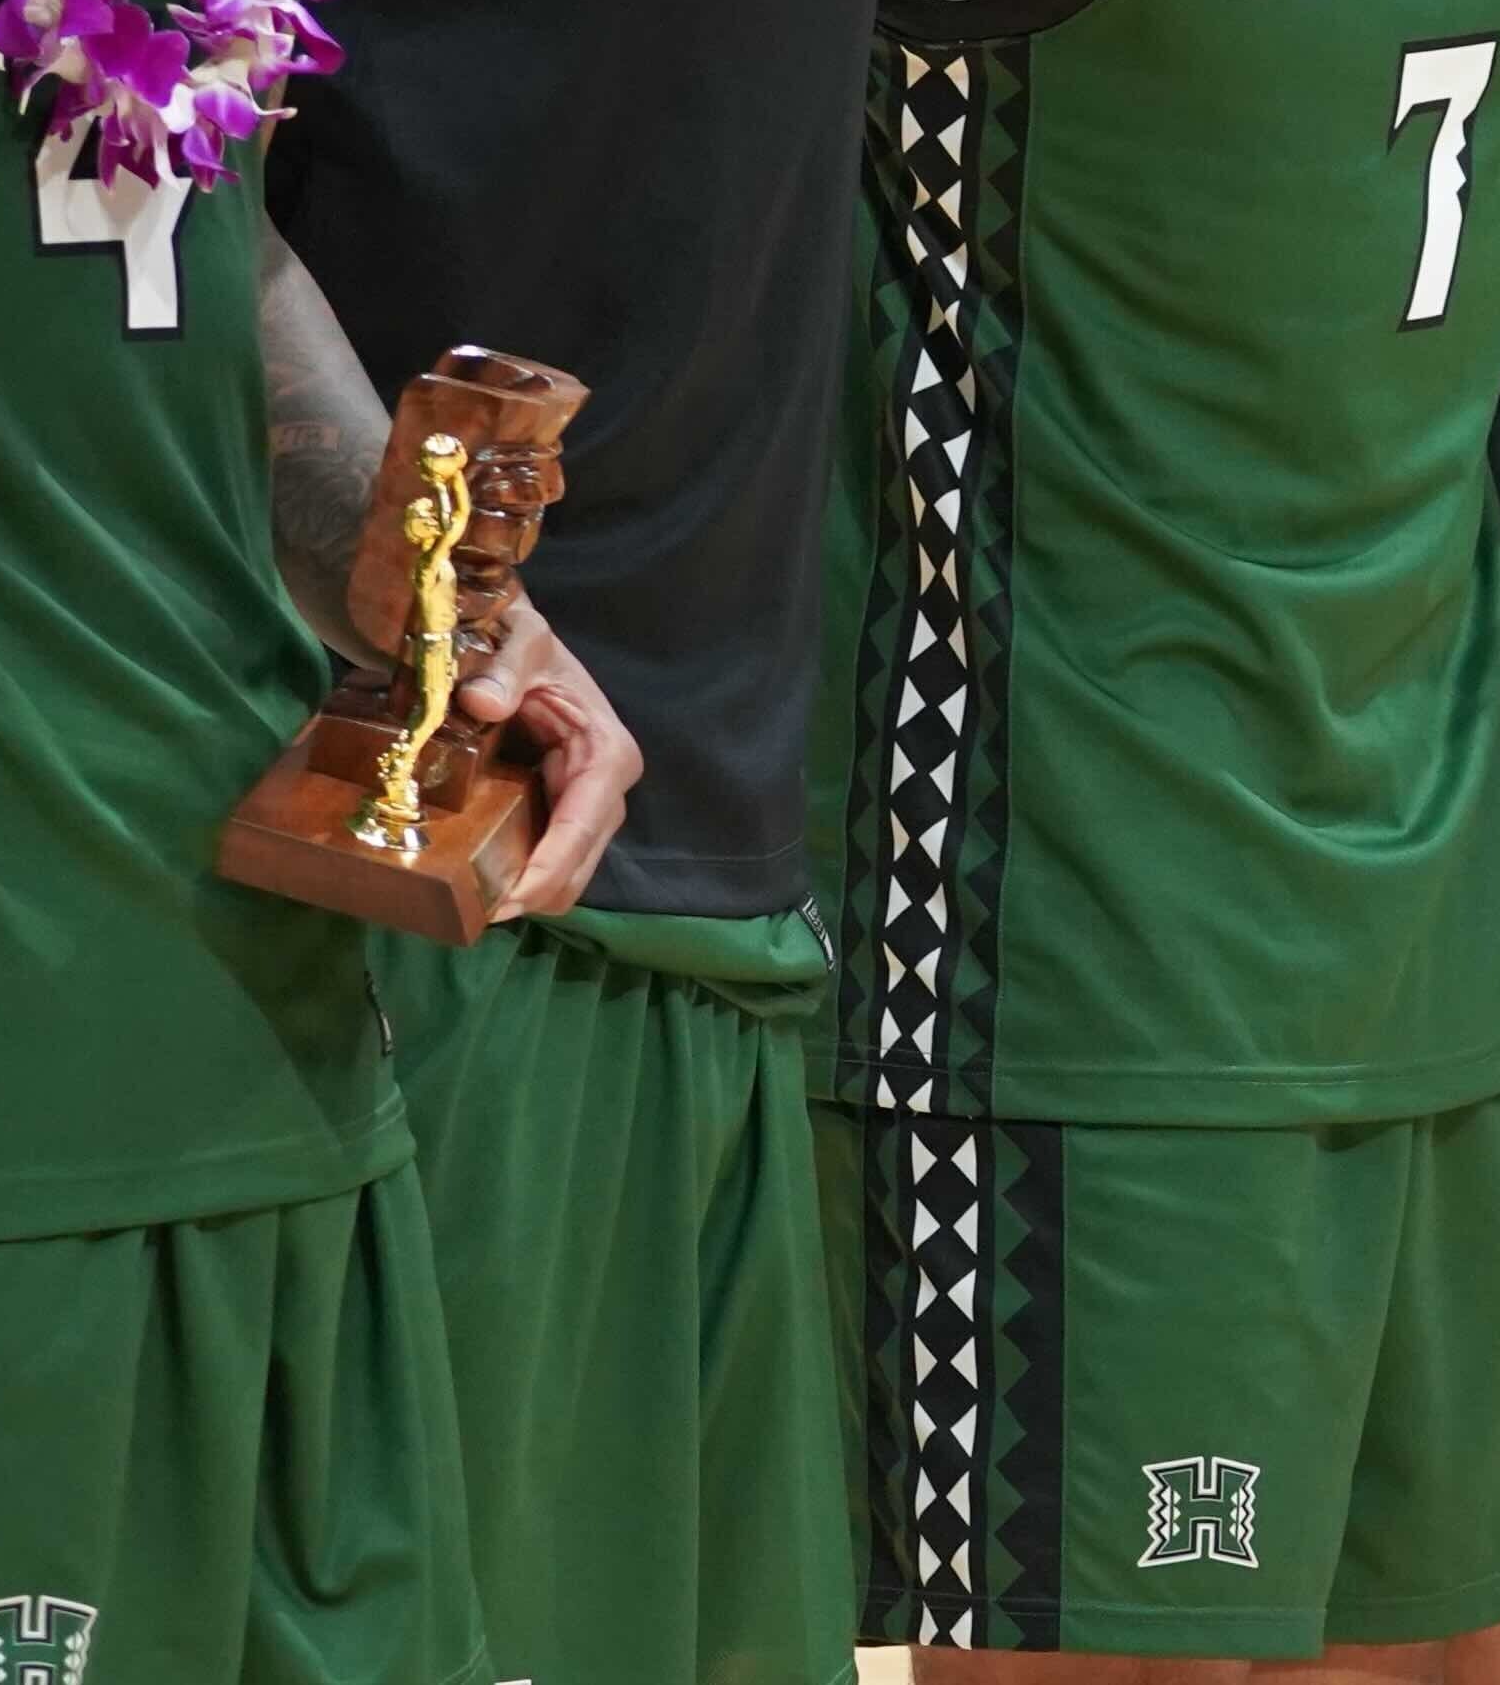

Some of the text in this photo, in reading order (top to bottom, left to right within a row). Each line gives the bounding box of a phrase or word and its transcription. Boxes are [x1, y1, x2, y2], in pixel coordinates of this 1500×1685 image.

[35, 105, 194, 331] 4
[1391, 37, 1500, 325] 7
[1137, 1455, 1261, 1569] H
